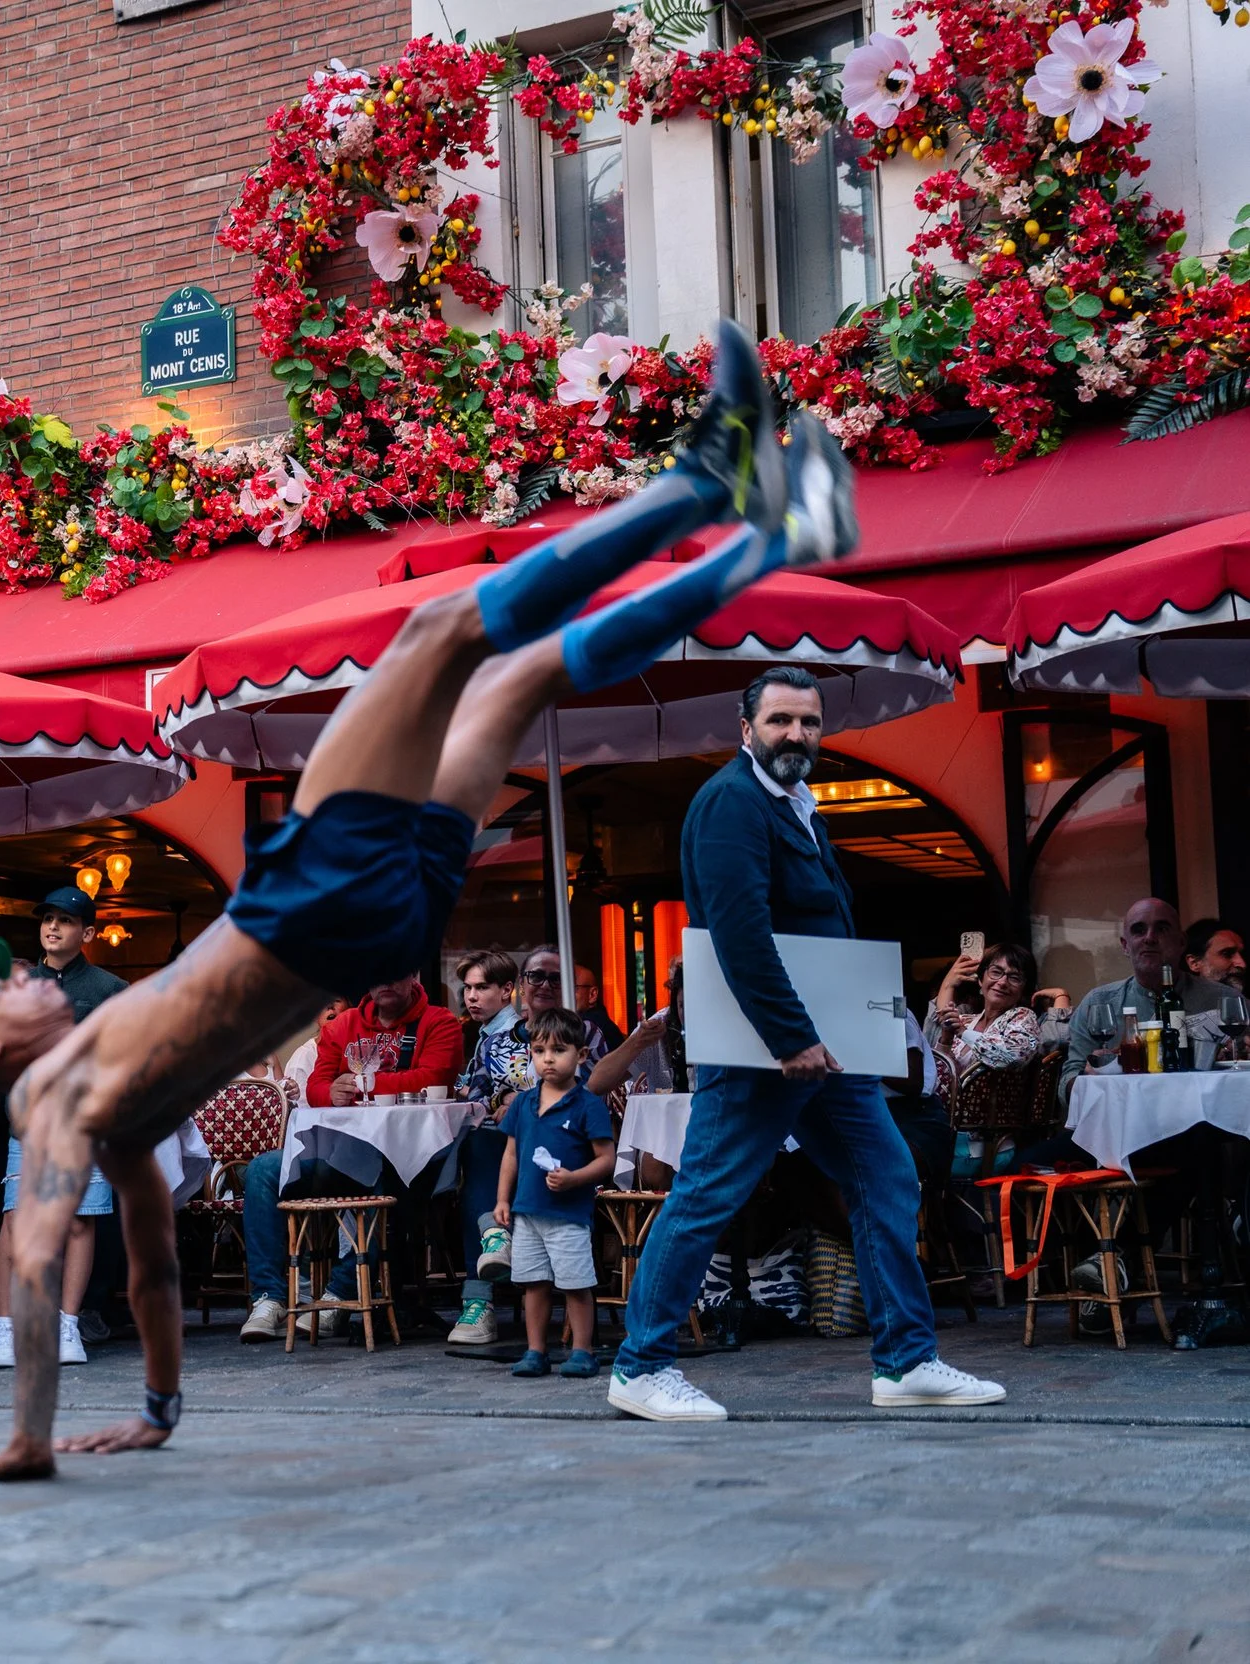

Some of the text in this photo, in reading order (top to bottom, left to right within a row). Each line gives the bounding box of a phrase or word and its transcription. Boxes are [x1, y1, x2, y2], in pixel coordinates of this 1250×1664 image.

[175, 328, 200, 347] RUE
[182, 347, 193, 357] DU
[150, 353, 226, 380] MONT CENIS
